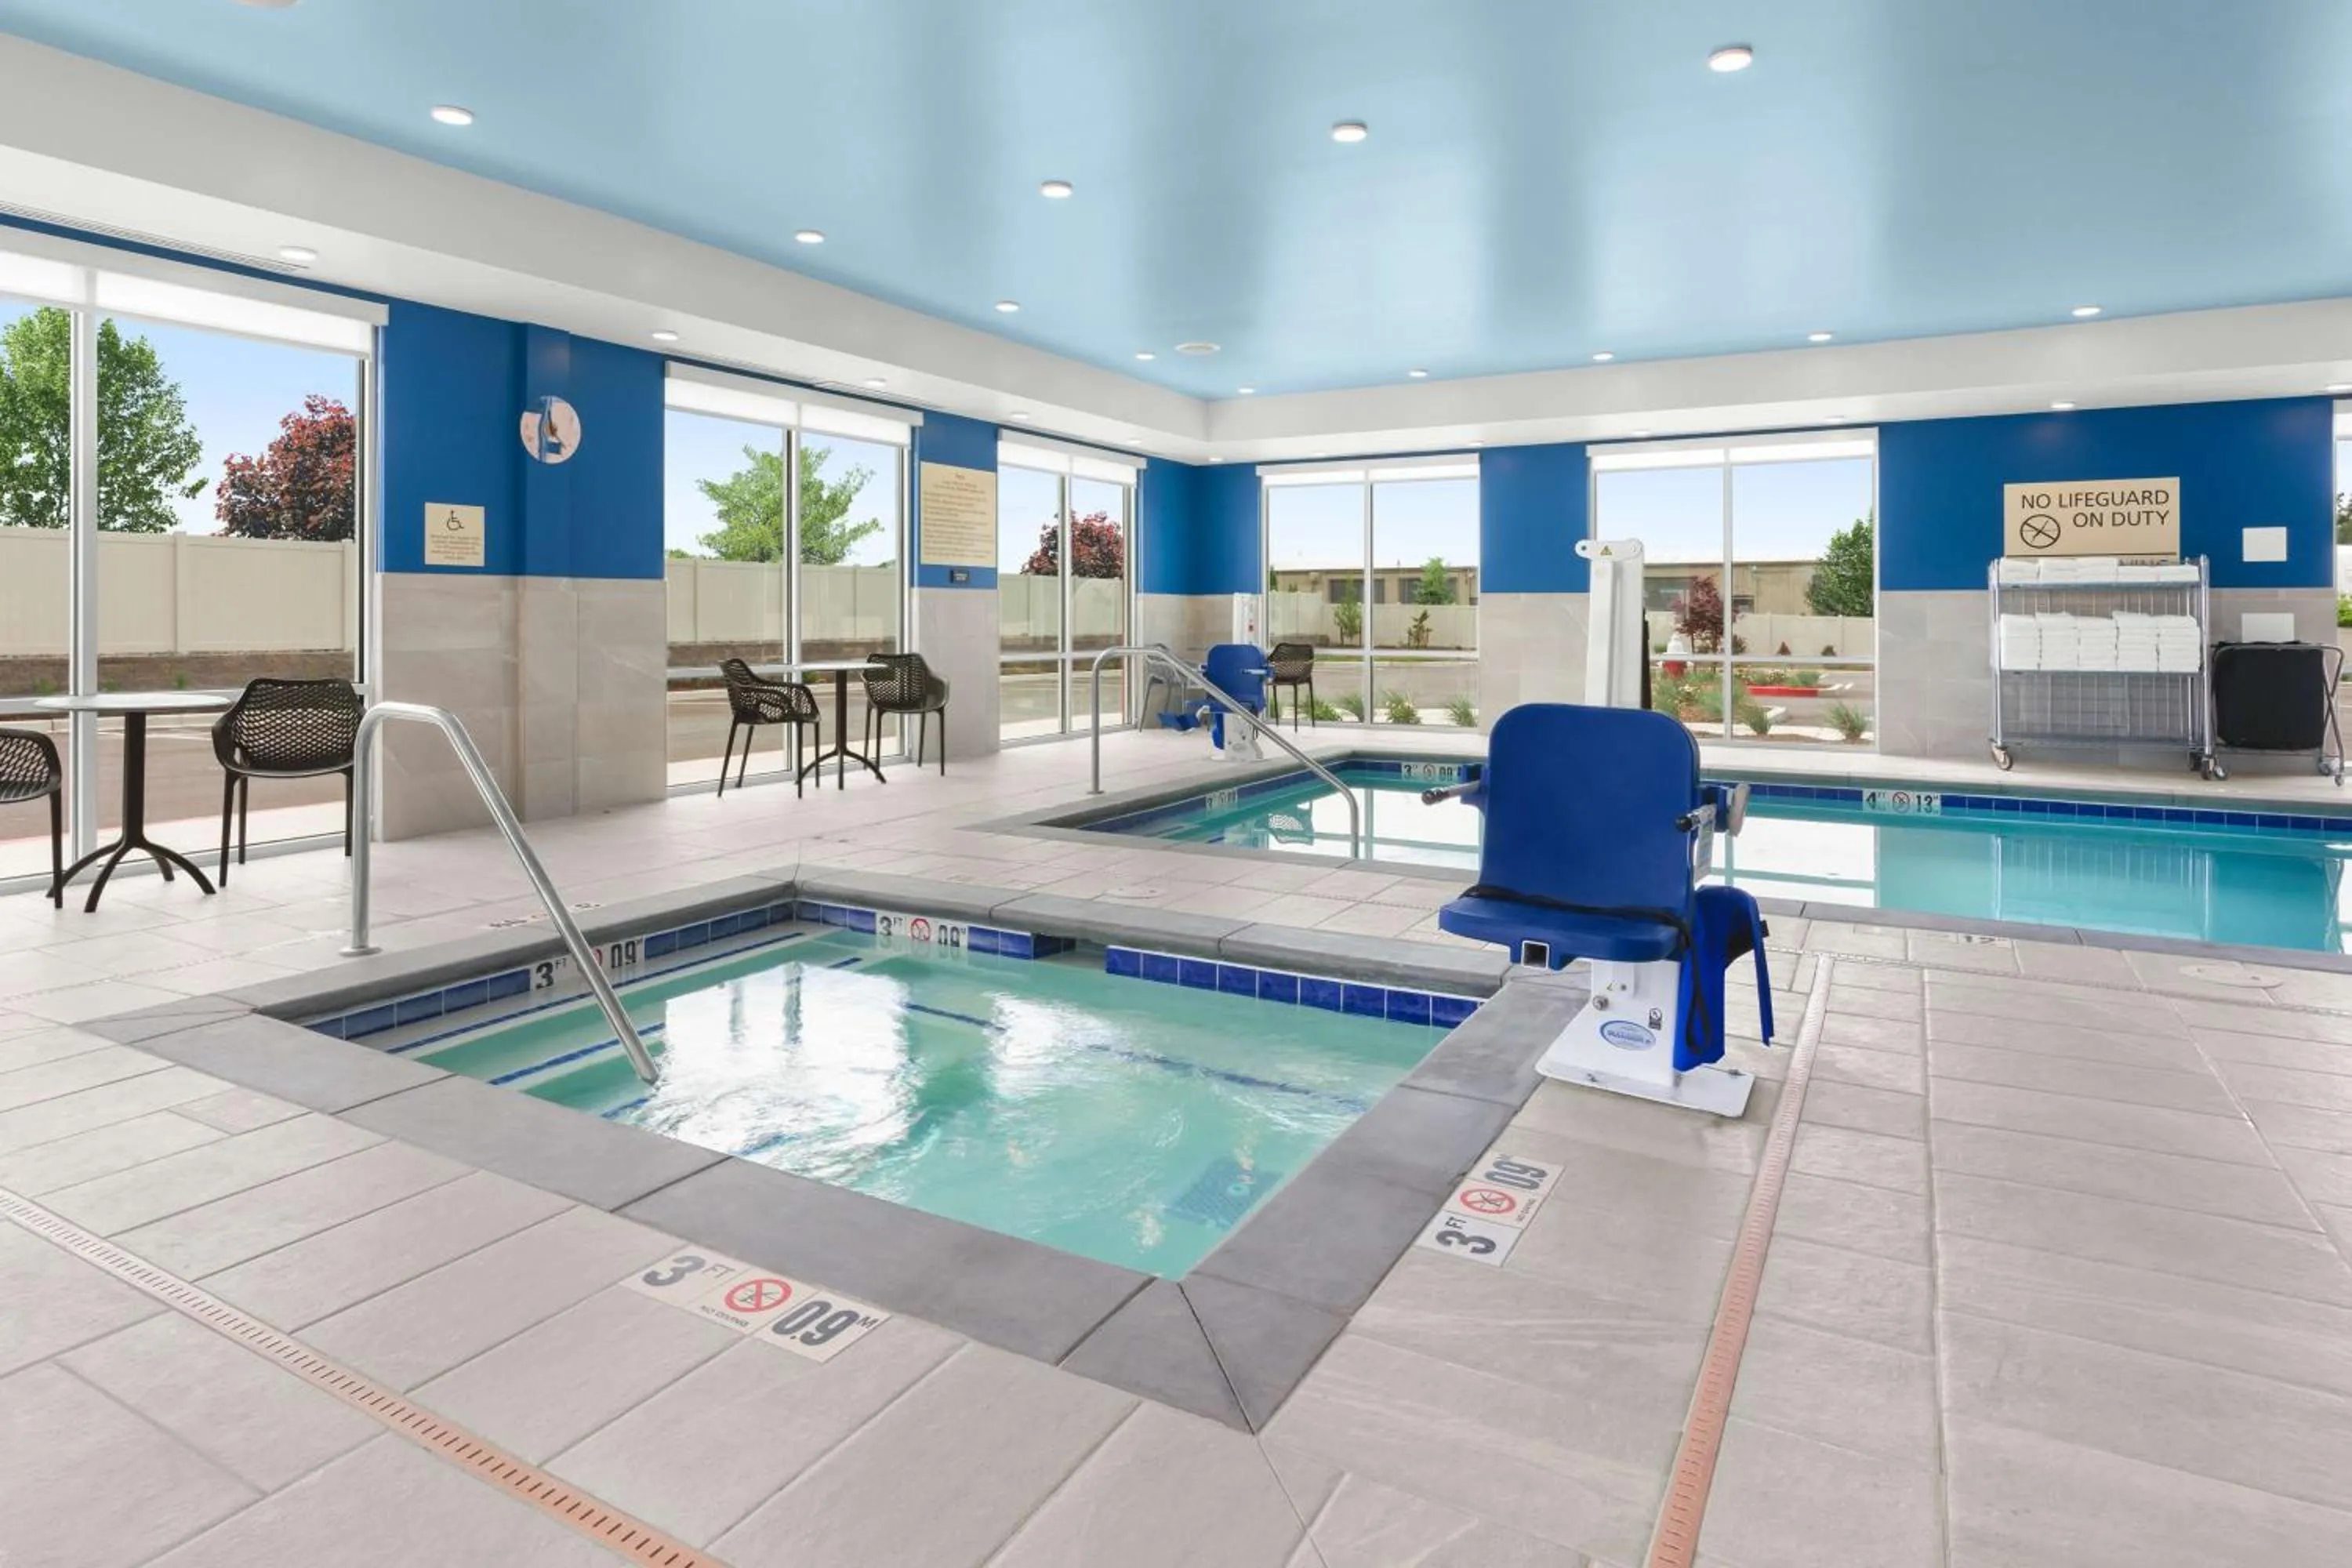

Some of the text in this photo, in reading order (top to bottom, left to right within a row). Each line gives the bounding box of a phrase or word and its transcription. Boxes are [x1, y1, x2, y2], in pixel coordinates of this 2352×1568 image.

[2021, 489, 2170, 510] NO LIFEGUARD
[2072, 510, 2170, 528] ON DUTY
[535, 961, 554, 990] 3
[1444, 1216, 1468, 1230] FT
[1436, 1230, 1497, 1254] 3
[642, 1255, 706, 1287] 3
[702, 1263, 736, 1279] FT
